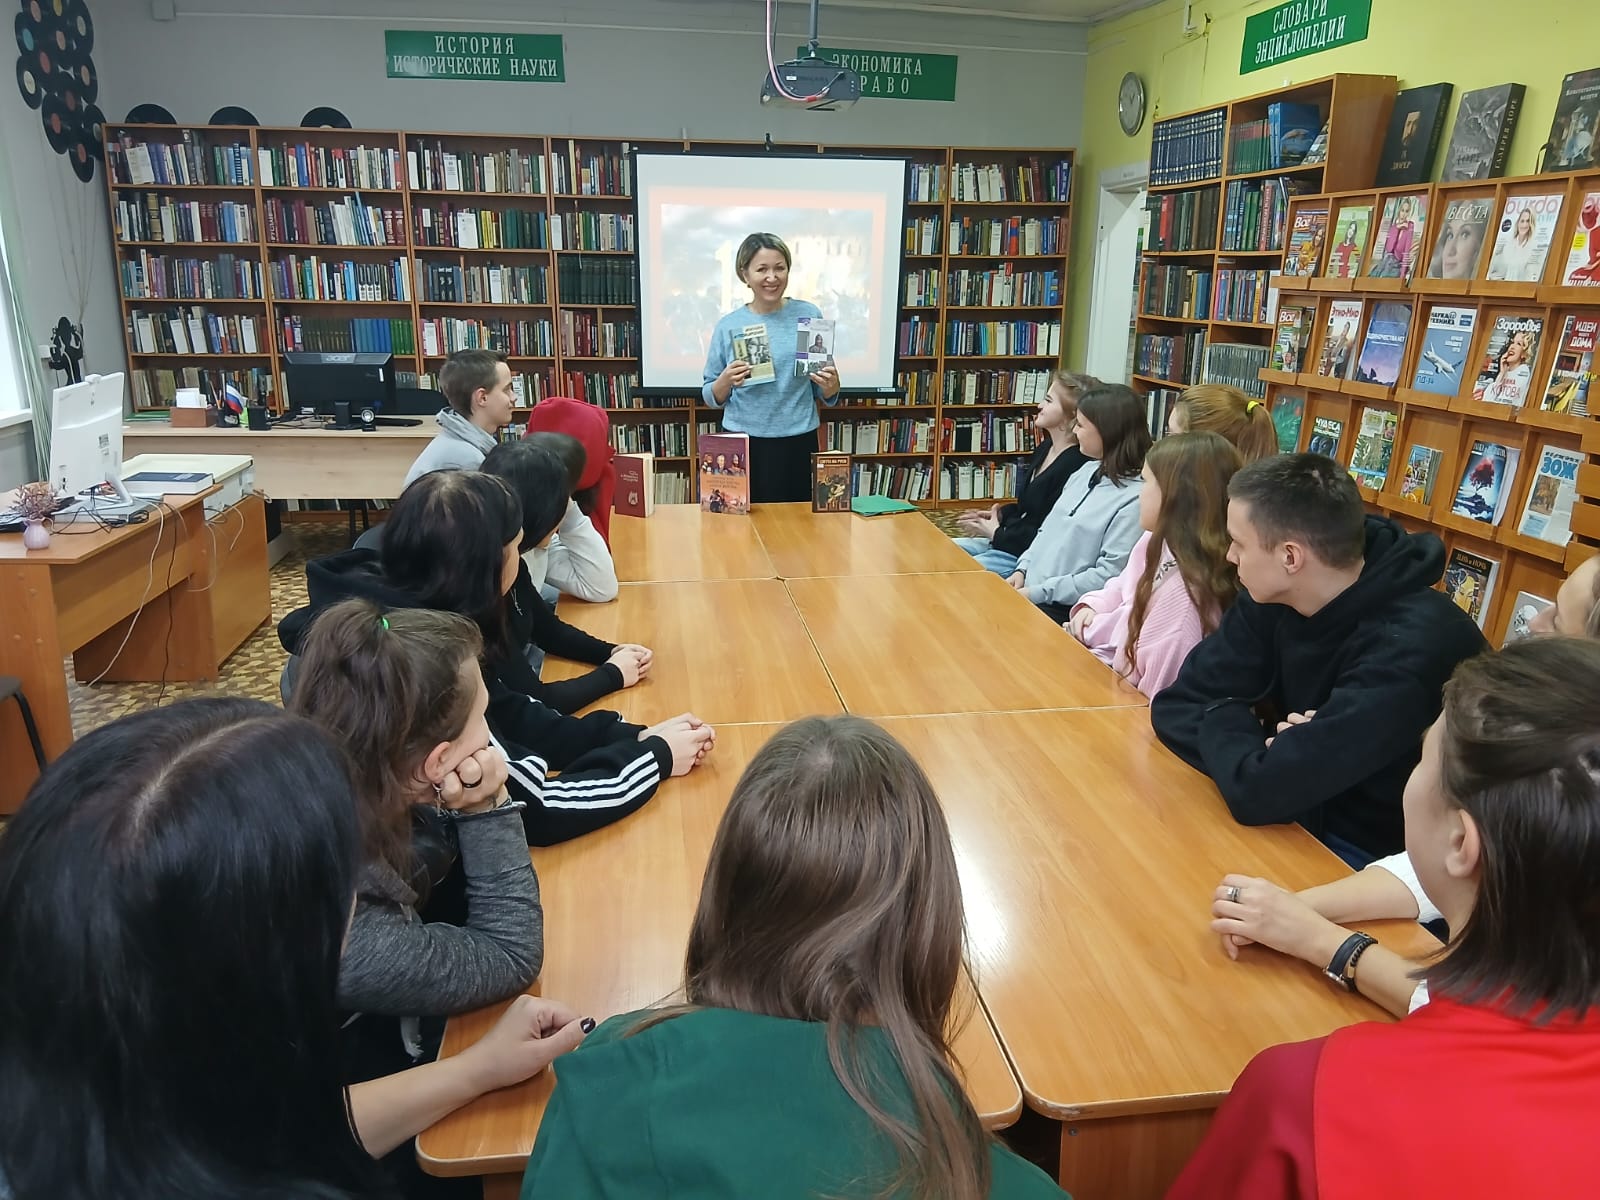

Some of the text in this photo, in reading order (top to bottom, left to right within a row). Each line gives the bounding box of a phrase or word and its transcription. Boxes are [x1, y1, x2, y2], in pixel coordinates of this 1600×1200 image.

[1273, 0, 1328, 33] СЛОВАРИ
[434, 35, 514, 55] ИСТОРИЯ
[1255, 15, 1347, 64] ЭНЦИКЛОПЕДИИ
[393, 55, 558, 77] ИСТОРИЧЕСКИЕ НАУКИ
[858, 75, 910, 94] РАВО
[1496, 318, 1541, 333] Здоровье
[1575, 321, 1597, 333] ИДЕИ
[1570, 337, 1593, 349] ДОМА
[1315, 417, 1341, 431] ЧУДЕСА
[1541, 456, 1578, 480] ЗОЖ
